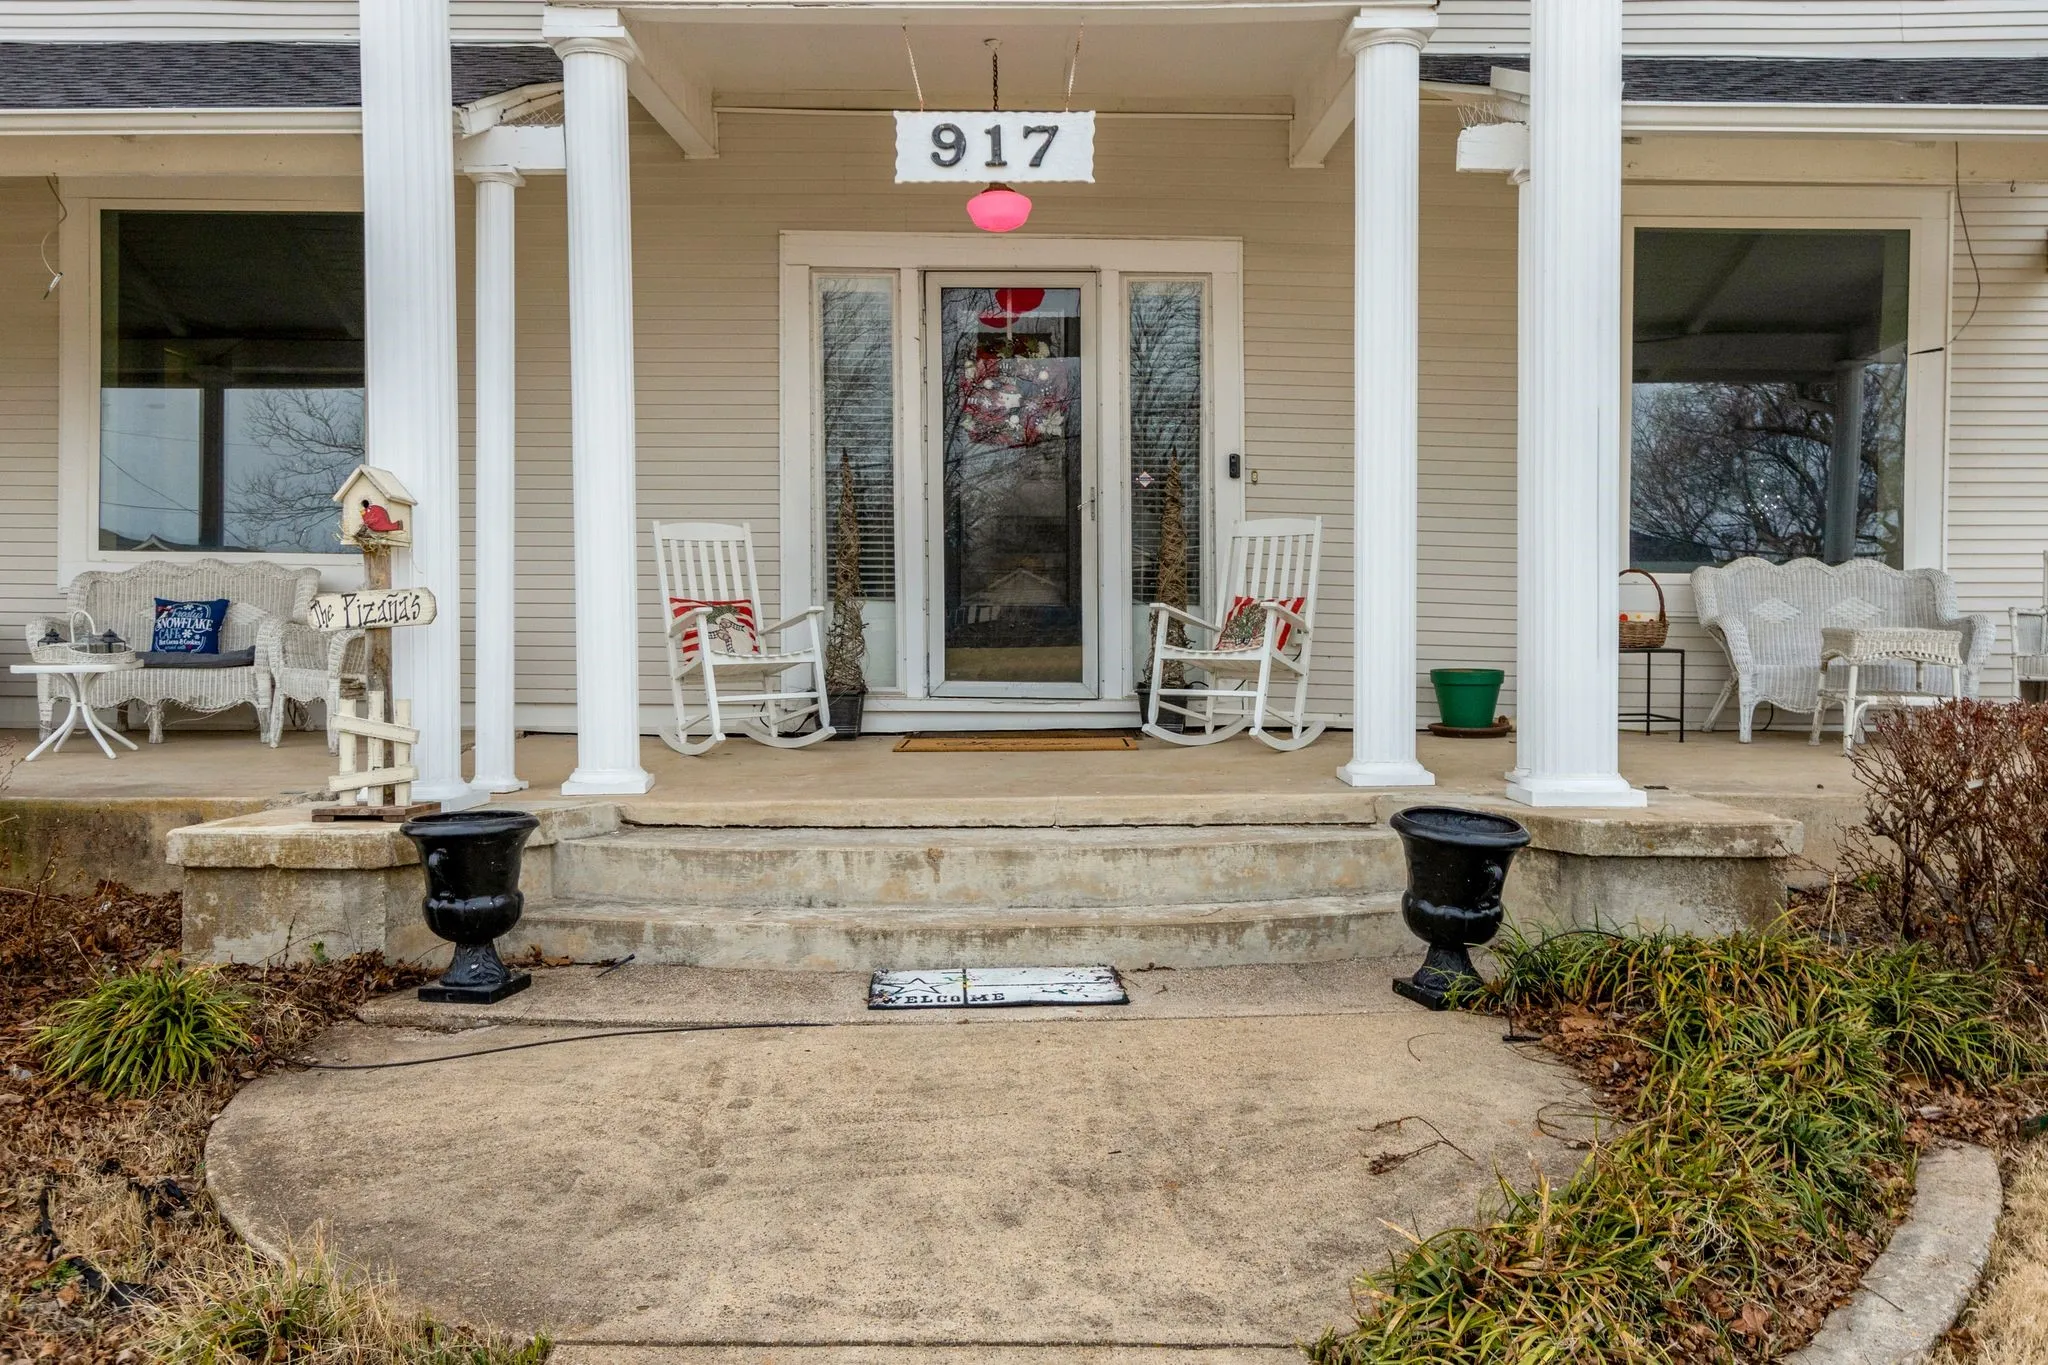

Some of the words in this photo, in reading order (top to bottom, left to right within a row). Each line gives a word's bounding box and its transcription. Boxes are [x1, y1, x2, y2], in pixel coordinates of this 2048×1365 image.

[930, 123, 1059, 168] 917
[311, 600, 334, 628] The
[341, 592, 420, 628] Pizaña's
[882, 992, 1005, 1005] WELCOME
